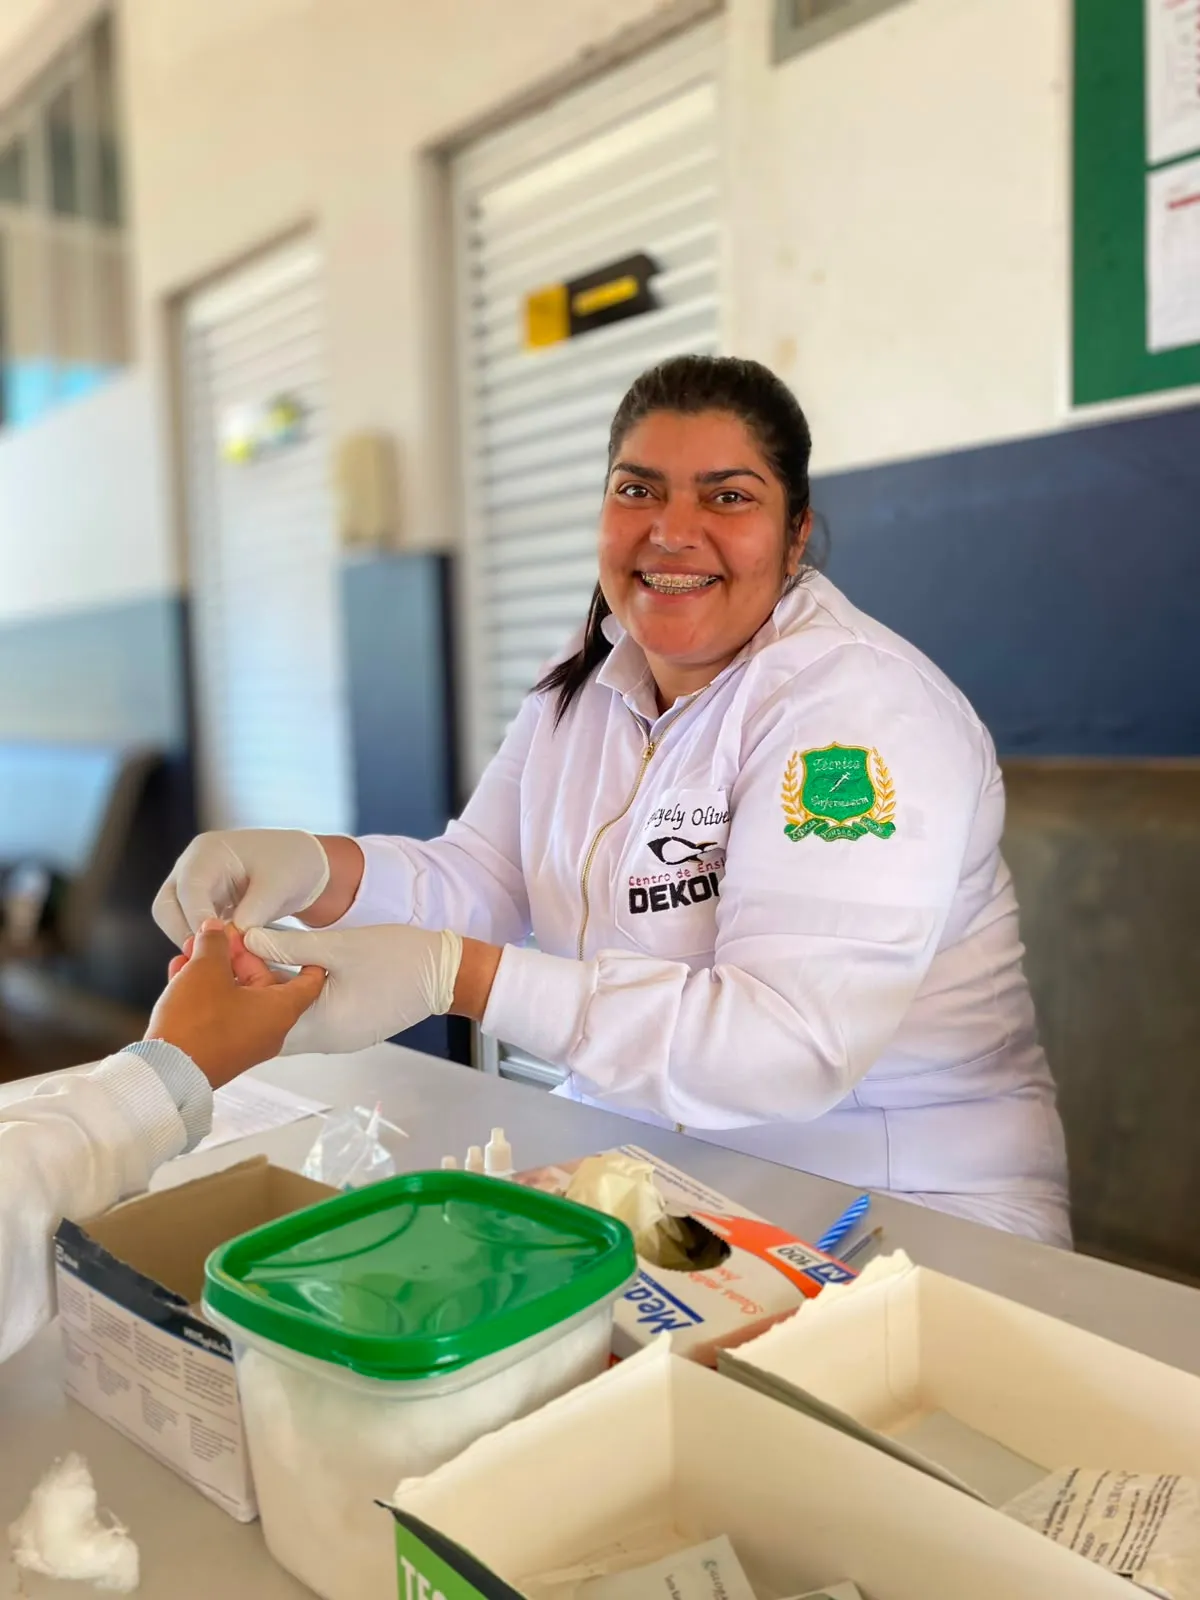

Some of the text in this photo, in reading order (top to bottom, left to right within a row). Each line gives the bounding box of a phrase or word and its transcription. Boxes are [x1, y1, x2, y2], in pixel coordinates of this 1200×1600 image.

[691, 805, 730, 826] Olive
[628, 857, 726, 887] Centro de Ensi
[777, 1247, 811, 1265] 100
